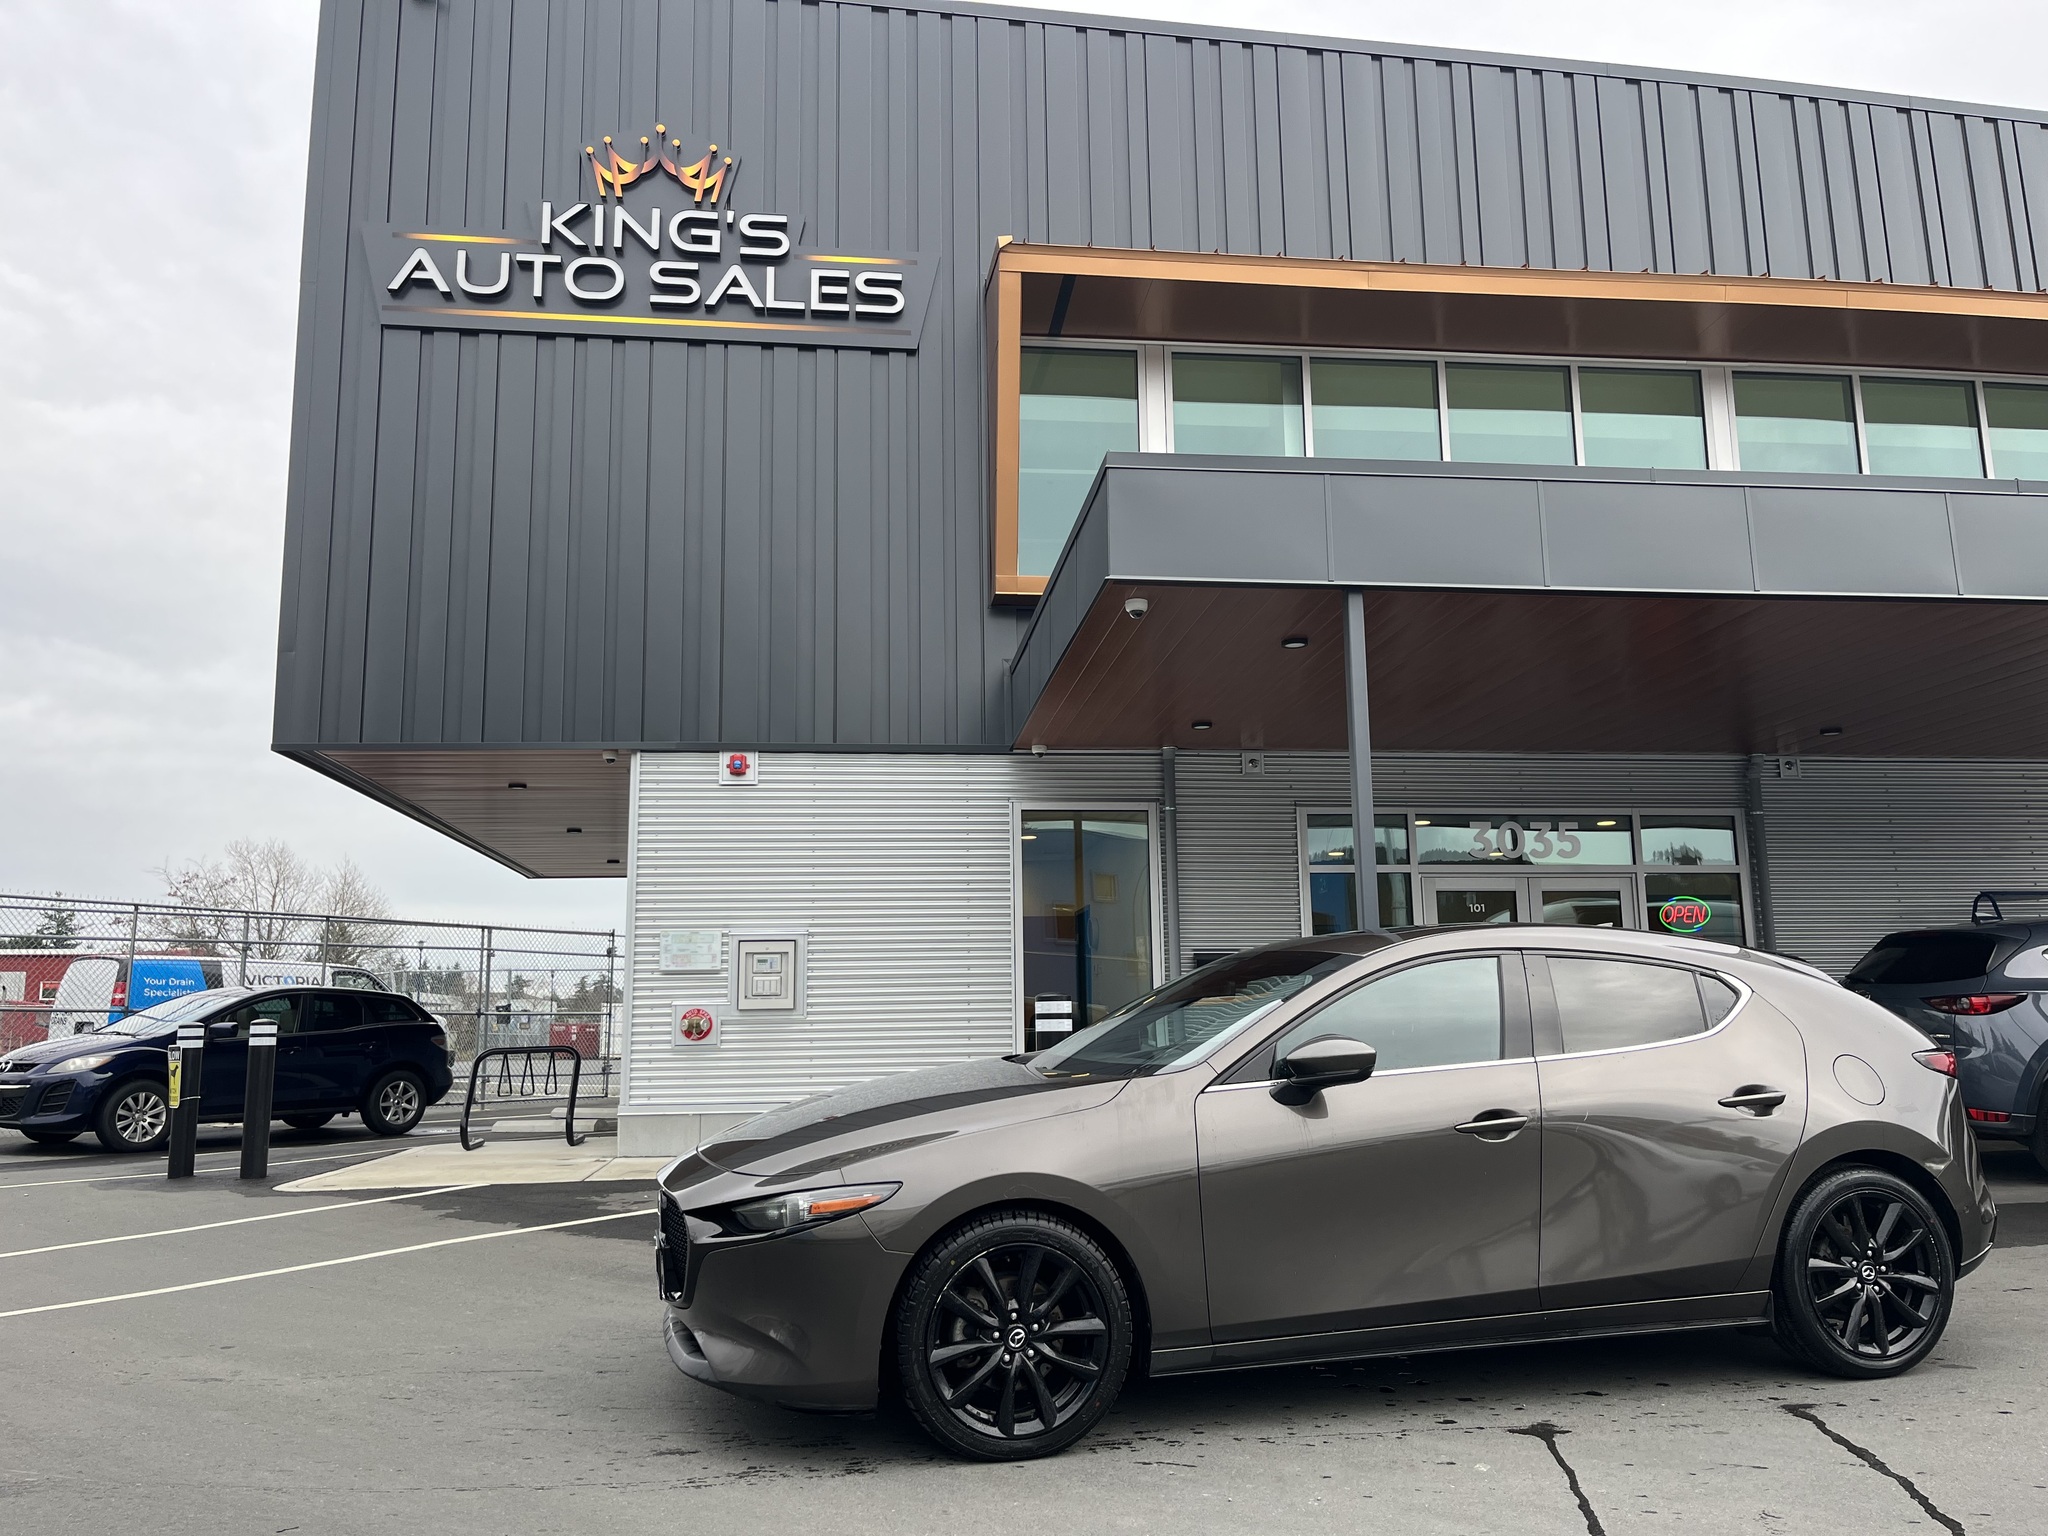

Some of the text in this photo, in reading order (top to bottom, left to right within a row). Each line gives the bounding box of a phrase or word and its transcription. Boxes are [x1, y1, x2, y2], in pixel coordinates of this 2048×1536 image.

[541, 201, 791, 258] KING'S
[386, 247, 906, 316] AUTO SALES
[1468, 821, 1581, 859] 3035
[1468, 903, 1486, 913] 101
[1662, 905, 1707, 923] OPEN
[143, 976, 195, 986] Your Drain
